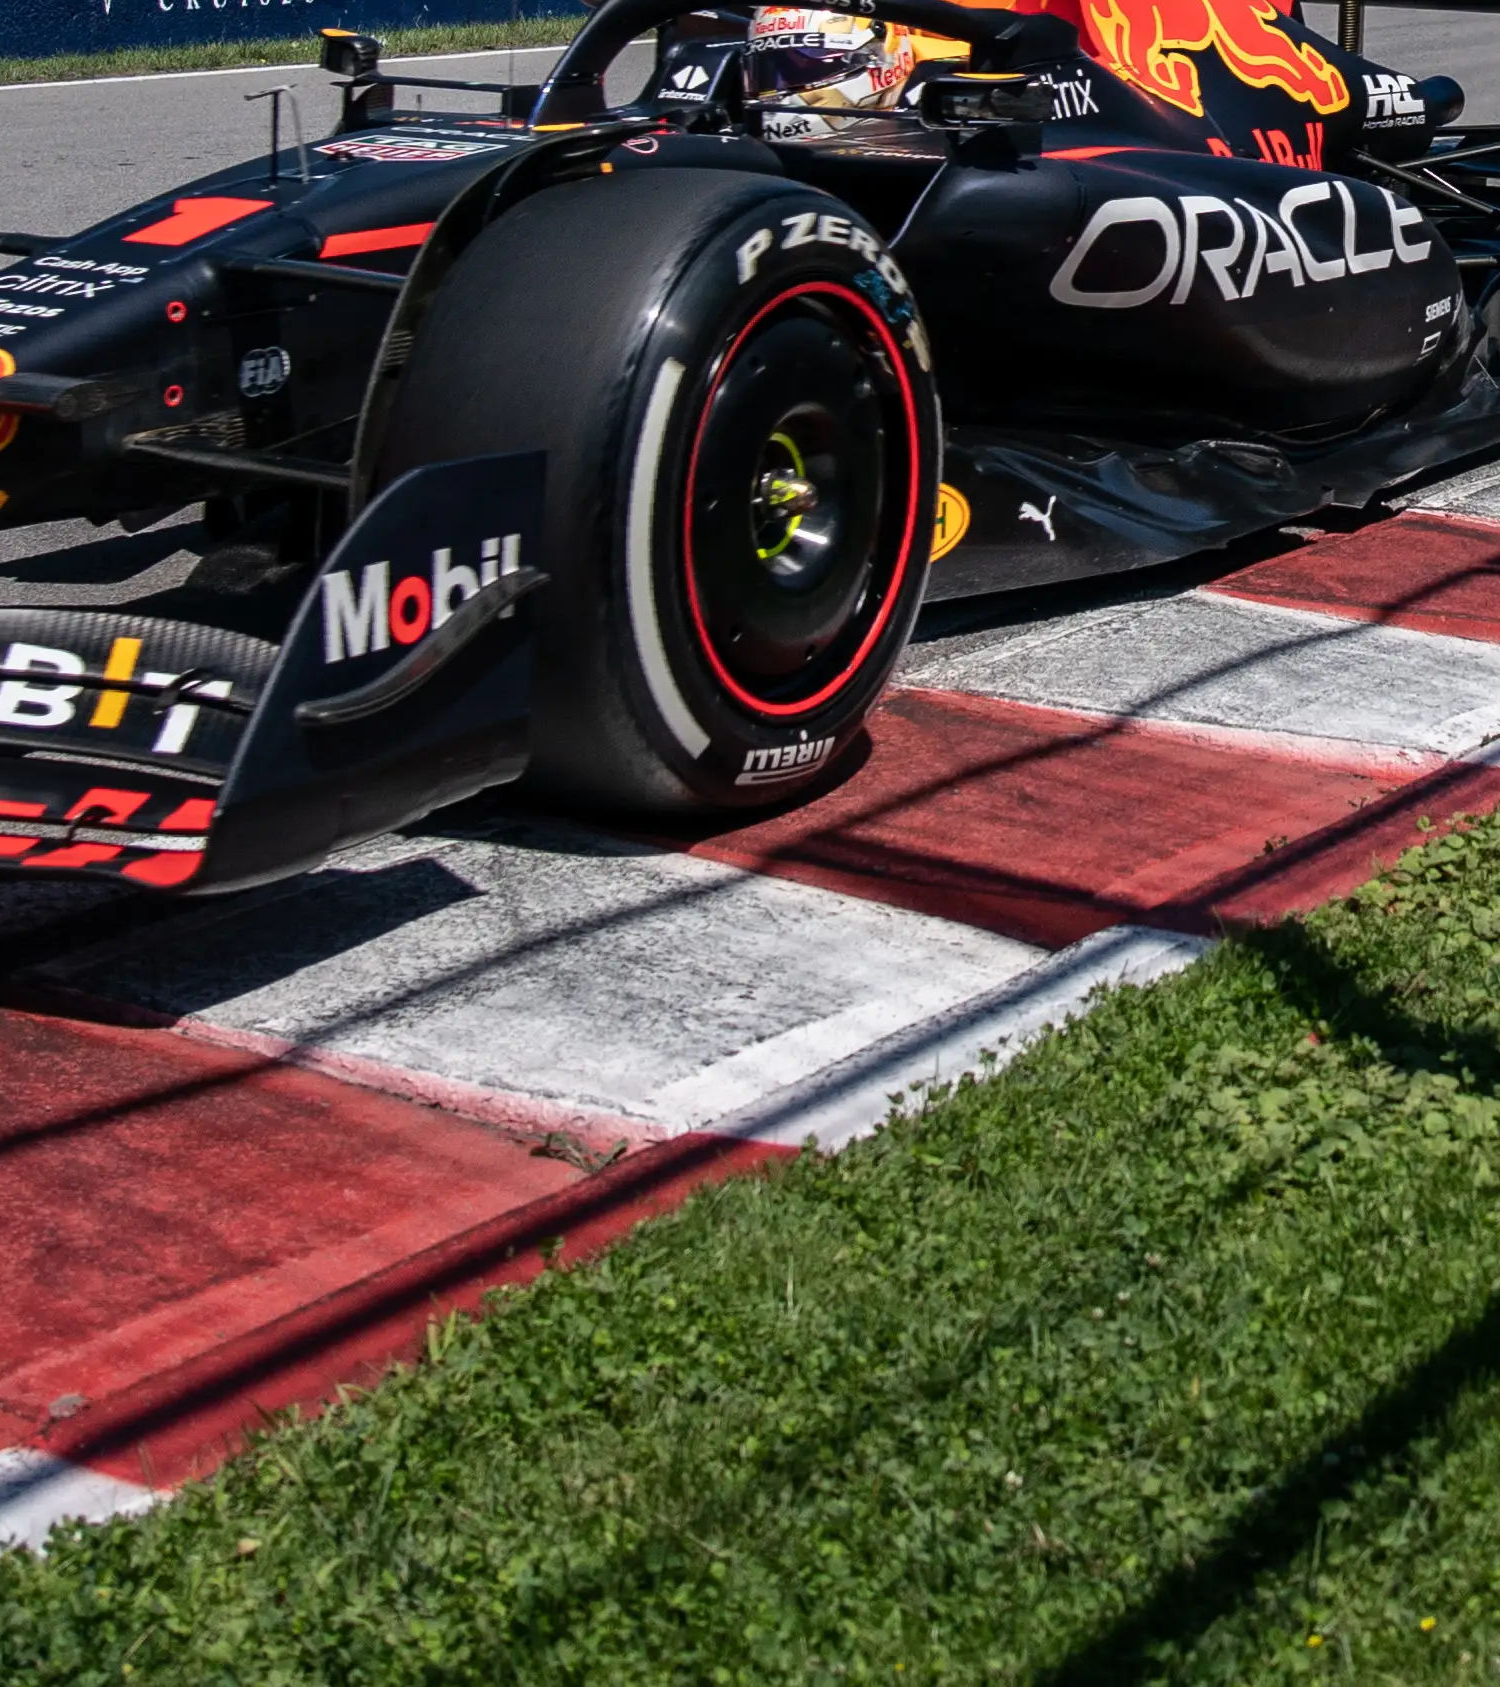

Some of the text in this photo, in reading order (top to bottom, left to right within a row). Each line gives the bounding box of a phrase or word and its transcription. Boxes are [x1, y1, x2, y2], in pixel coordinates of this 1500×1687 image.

[755, 16, 805, 34] Red Bull
[1361, 73, 1426, 119] HRC
[766, 118, 812, 142] Next
[1362, 114, 1426, 130] Honda RACING
[373, 136, 486, 151] TAG
[736, 212, 909, 295] P ZERO
[1048, 180, 1432, 309] ORACLE
[33, 256, 150, 276] Cash App
[1425, 296, 1452, 323] SIEMENS
[322, 533, 522, 665] Mobil
